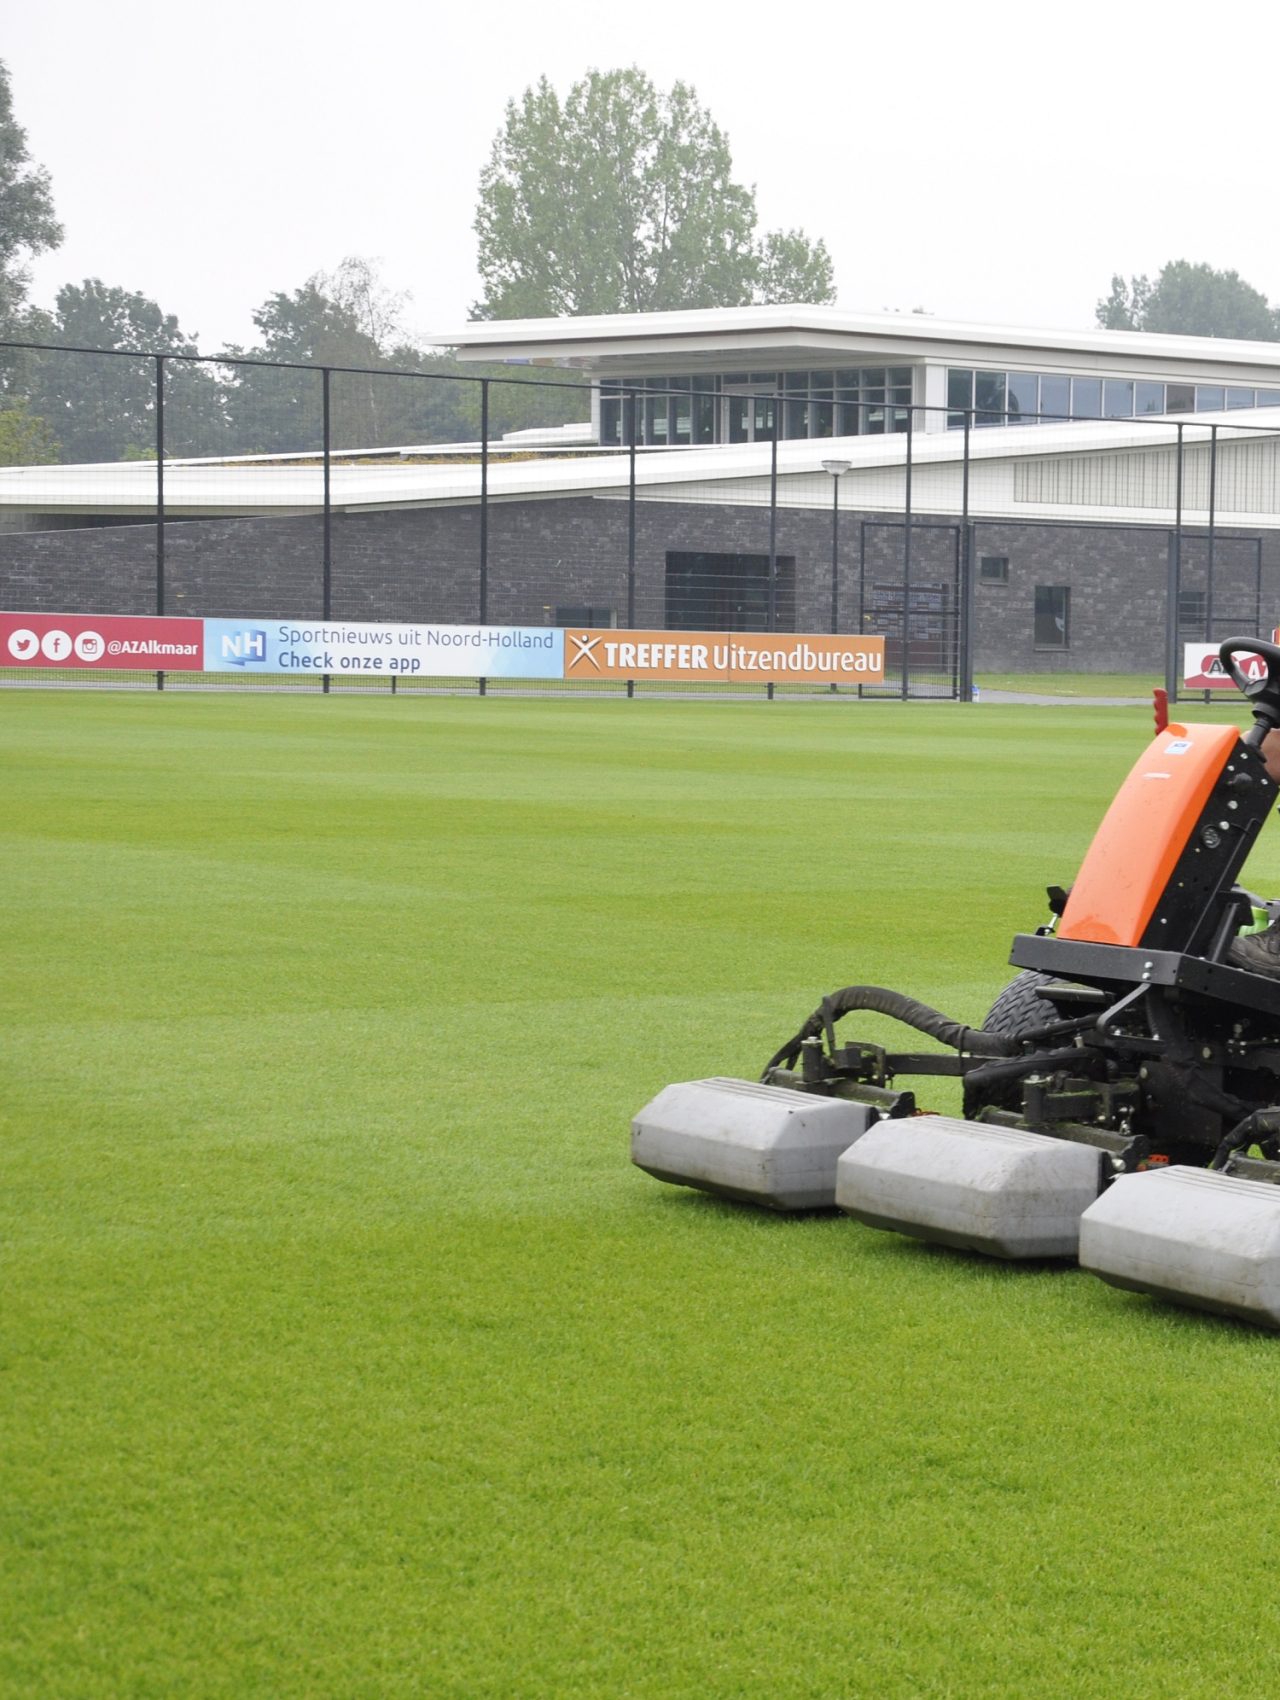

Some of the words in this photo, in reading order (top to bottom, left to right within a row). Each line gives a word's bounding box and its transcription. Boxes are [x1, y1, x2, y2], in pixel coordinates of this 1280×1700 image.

[108, 640, 199, 656] @AZAlkmaar
[222, 632, 263, 658] NH
[279, 626, 393, 646] Sportnieuws
[399, 630, 421, 646] uit
[427, 630, 554, 649] Noord-Holland
[279, 651, 333, 669] Check
[340, 656, 383, 670] onze
[389, 656, 421, 673] app
[604, 642, 708, 670] TREFFER
[713, 643, 881, 672] Uitzendbureau
